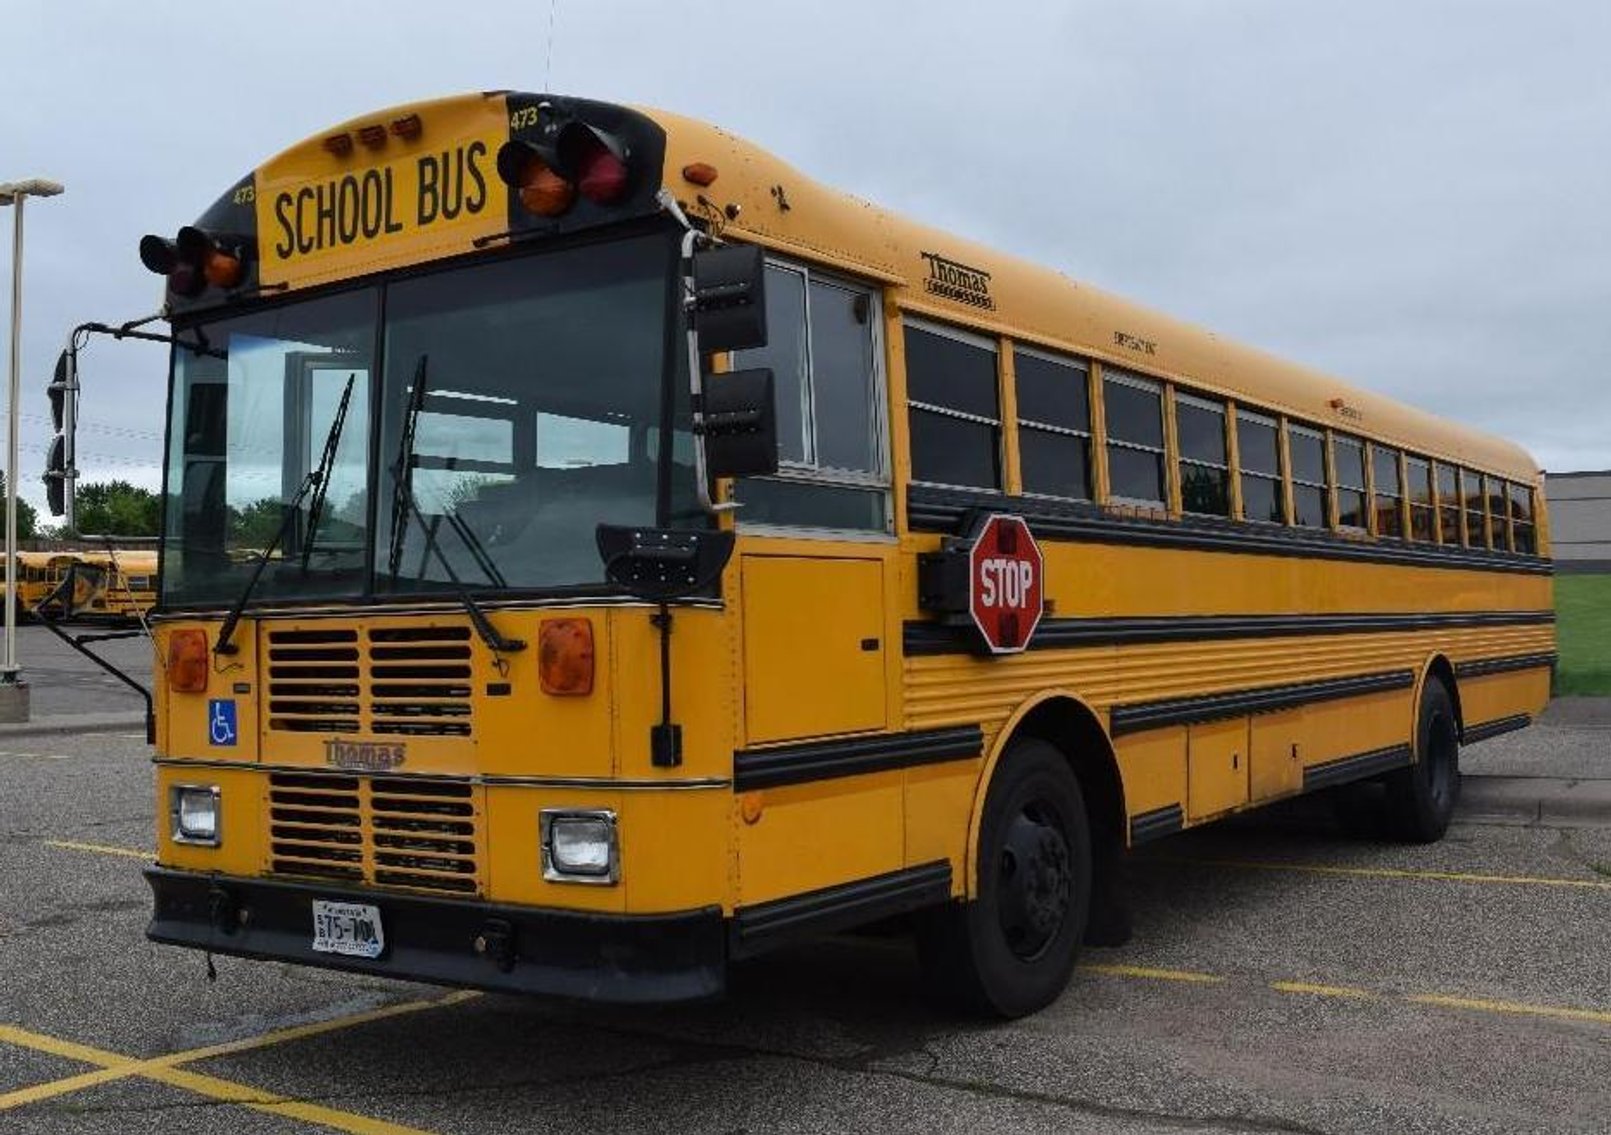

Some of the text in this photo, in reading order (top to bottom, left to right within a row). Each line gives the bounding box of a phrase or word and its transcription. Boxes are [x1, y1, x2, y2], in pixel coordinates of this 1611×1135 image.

[511, 106, 538, 131] 473
[233, 186, 255, 205] 473
[276, 142, 486, 260] SCHOOL BUS
[920, 251, 992, 294] Thomas
[982, 558, 1032, 608] STOP
[323, 737, 406, 766] Thomas
